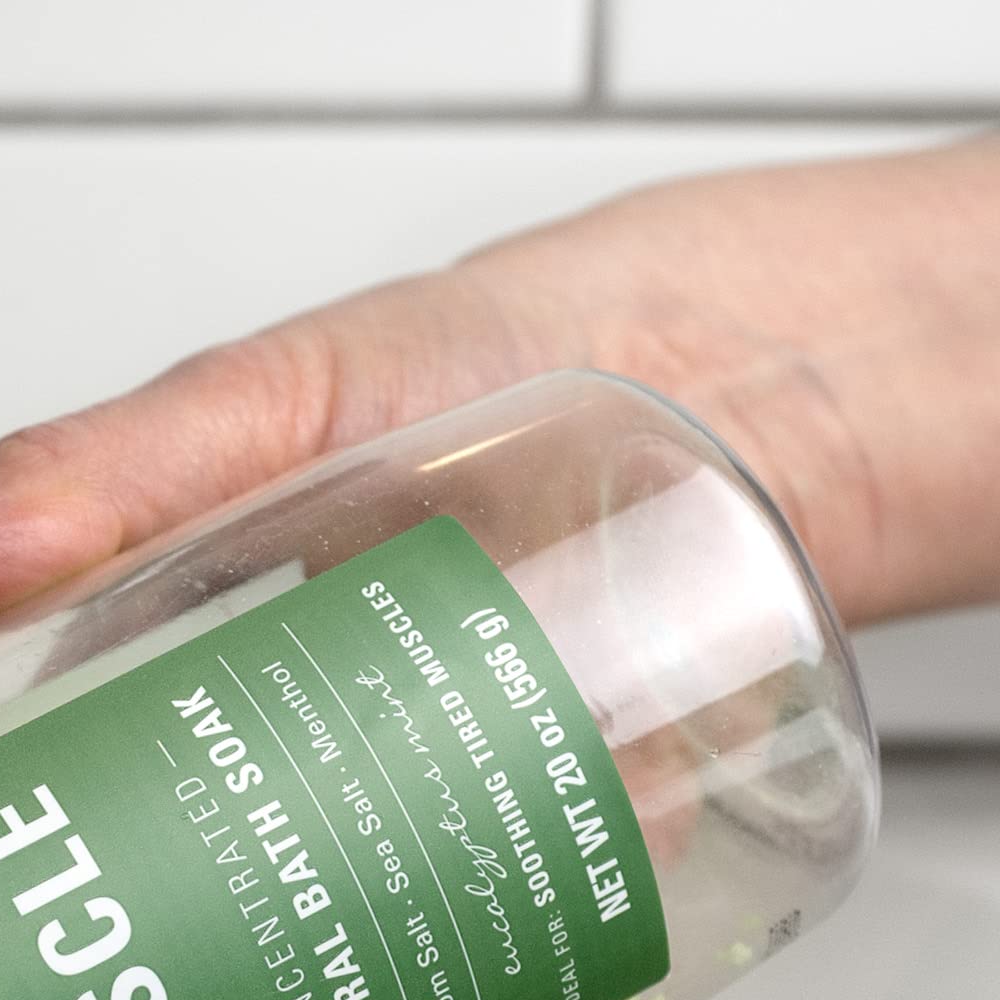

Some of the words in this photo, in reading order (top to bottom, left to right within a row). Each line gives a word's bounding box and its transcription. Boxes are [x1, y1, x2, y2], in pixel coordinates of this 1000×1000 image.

[361, 581, 450, 688] MUSCLES
[460, 607, 510, 640] g)
[354, 664, 430, 753] mint
[484, 642, 547, 710] (566
[170, 685, 264, 794] SOAK
[260, 660, 343, 764] Menthol
[439, 690, 495, 770] TIRED
[529, 707, 566, 748] oz
[341, 777, 382, 836] Salt
[545, 751, 588, 796] 20
[246, 799, 332, 921] BATH
[484, 770, 556, 908] SOOTHING
[562, 797, 610, 859] WT
[375, 838, 410, 895] Sea
[423, 758, 522, 976] eucalyptus
[585, 857, 632, 923] NET
[405, 911, 440, 969] Salt
[547, 908, 572, 958] FOR:
